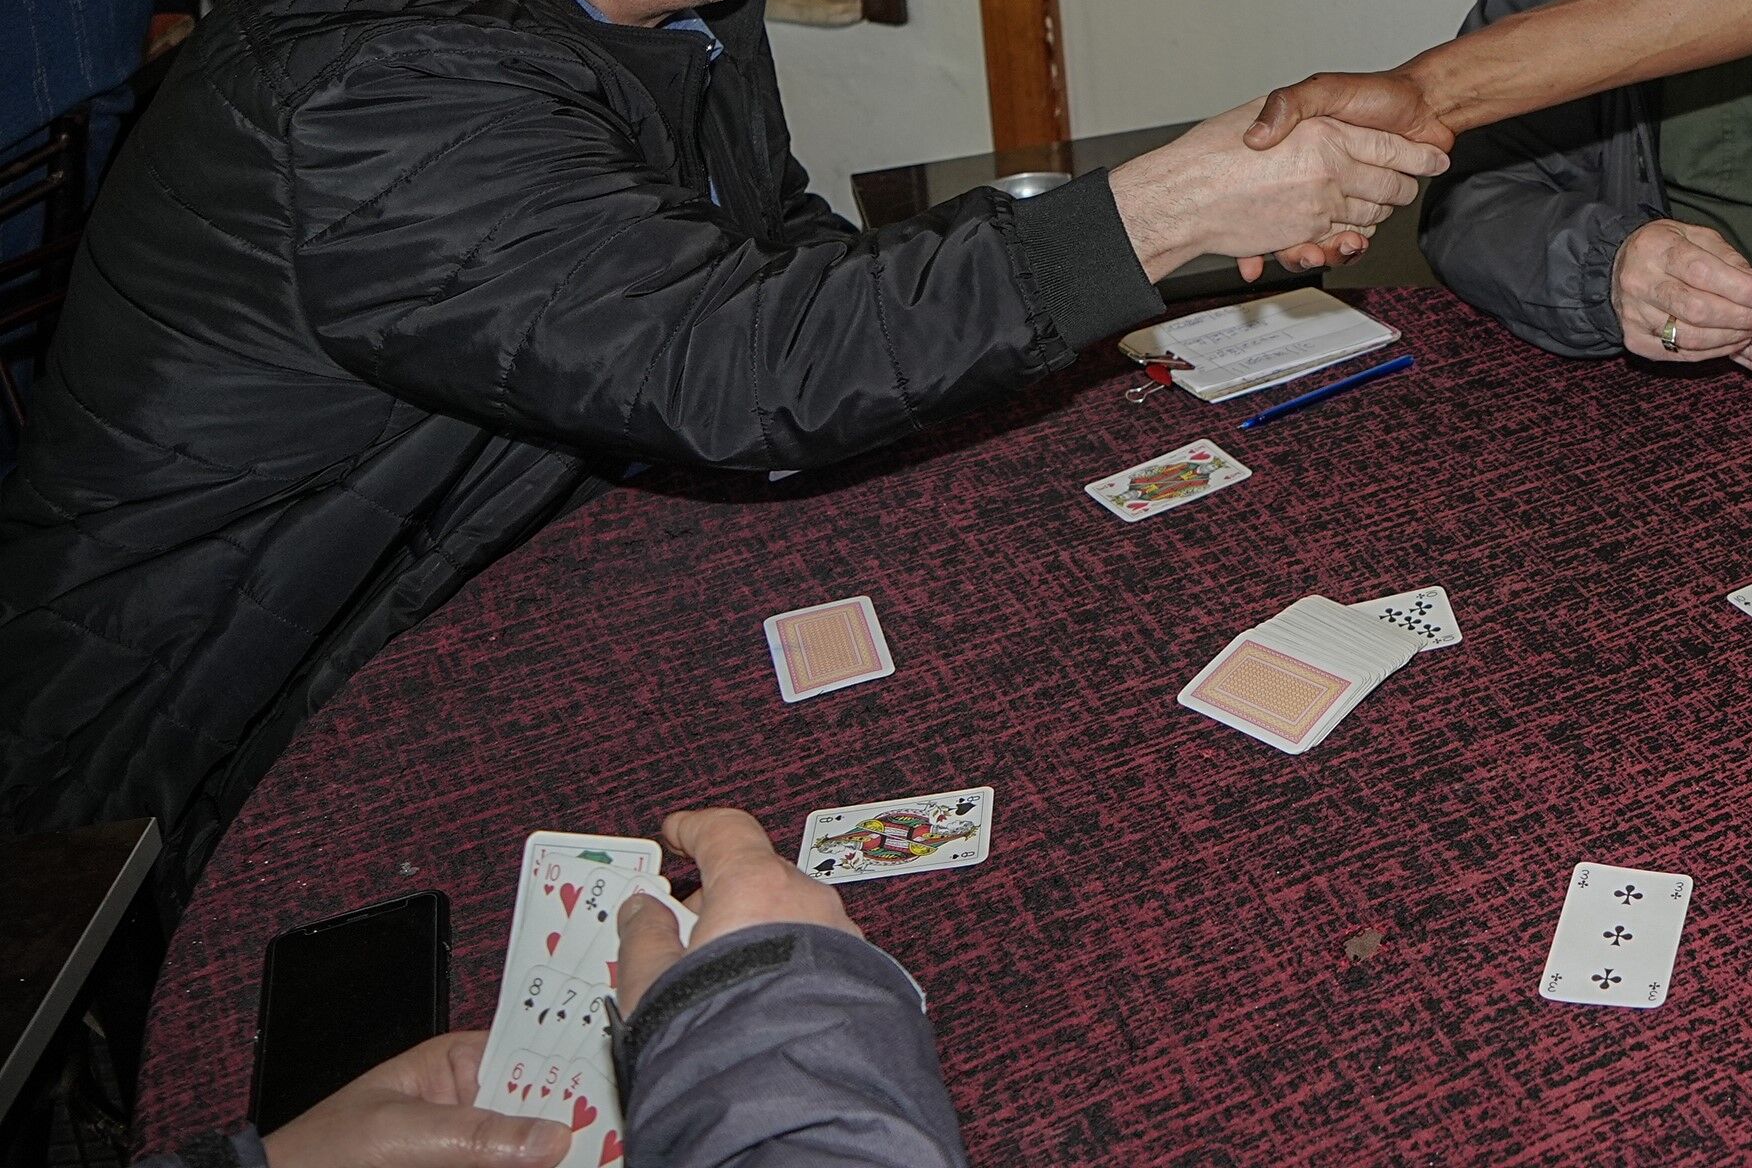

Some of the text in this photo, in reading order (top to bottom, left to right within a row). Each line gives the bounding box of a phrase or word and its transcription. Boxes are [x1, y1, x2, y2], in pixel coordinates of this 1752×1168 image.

[544, 863, 561, 882] 10
[1580, 869, 1590, 881] 3
[591, 878, 606, 897] 8
[1675, 881, 1685, 892] 3
[528, 977, 543, 996] 8
[1547, 982, 1558, 993] 3
[1648, 990, 1657, 1001] 3
[562, 989, 578, 1006] 7
[589, 996, 604, 1013] 6
[512, 1062, 525, 1081] 6
[545, 1065, 560, 1085] 5
[571, 1071, 583, 1090] 4
